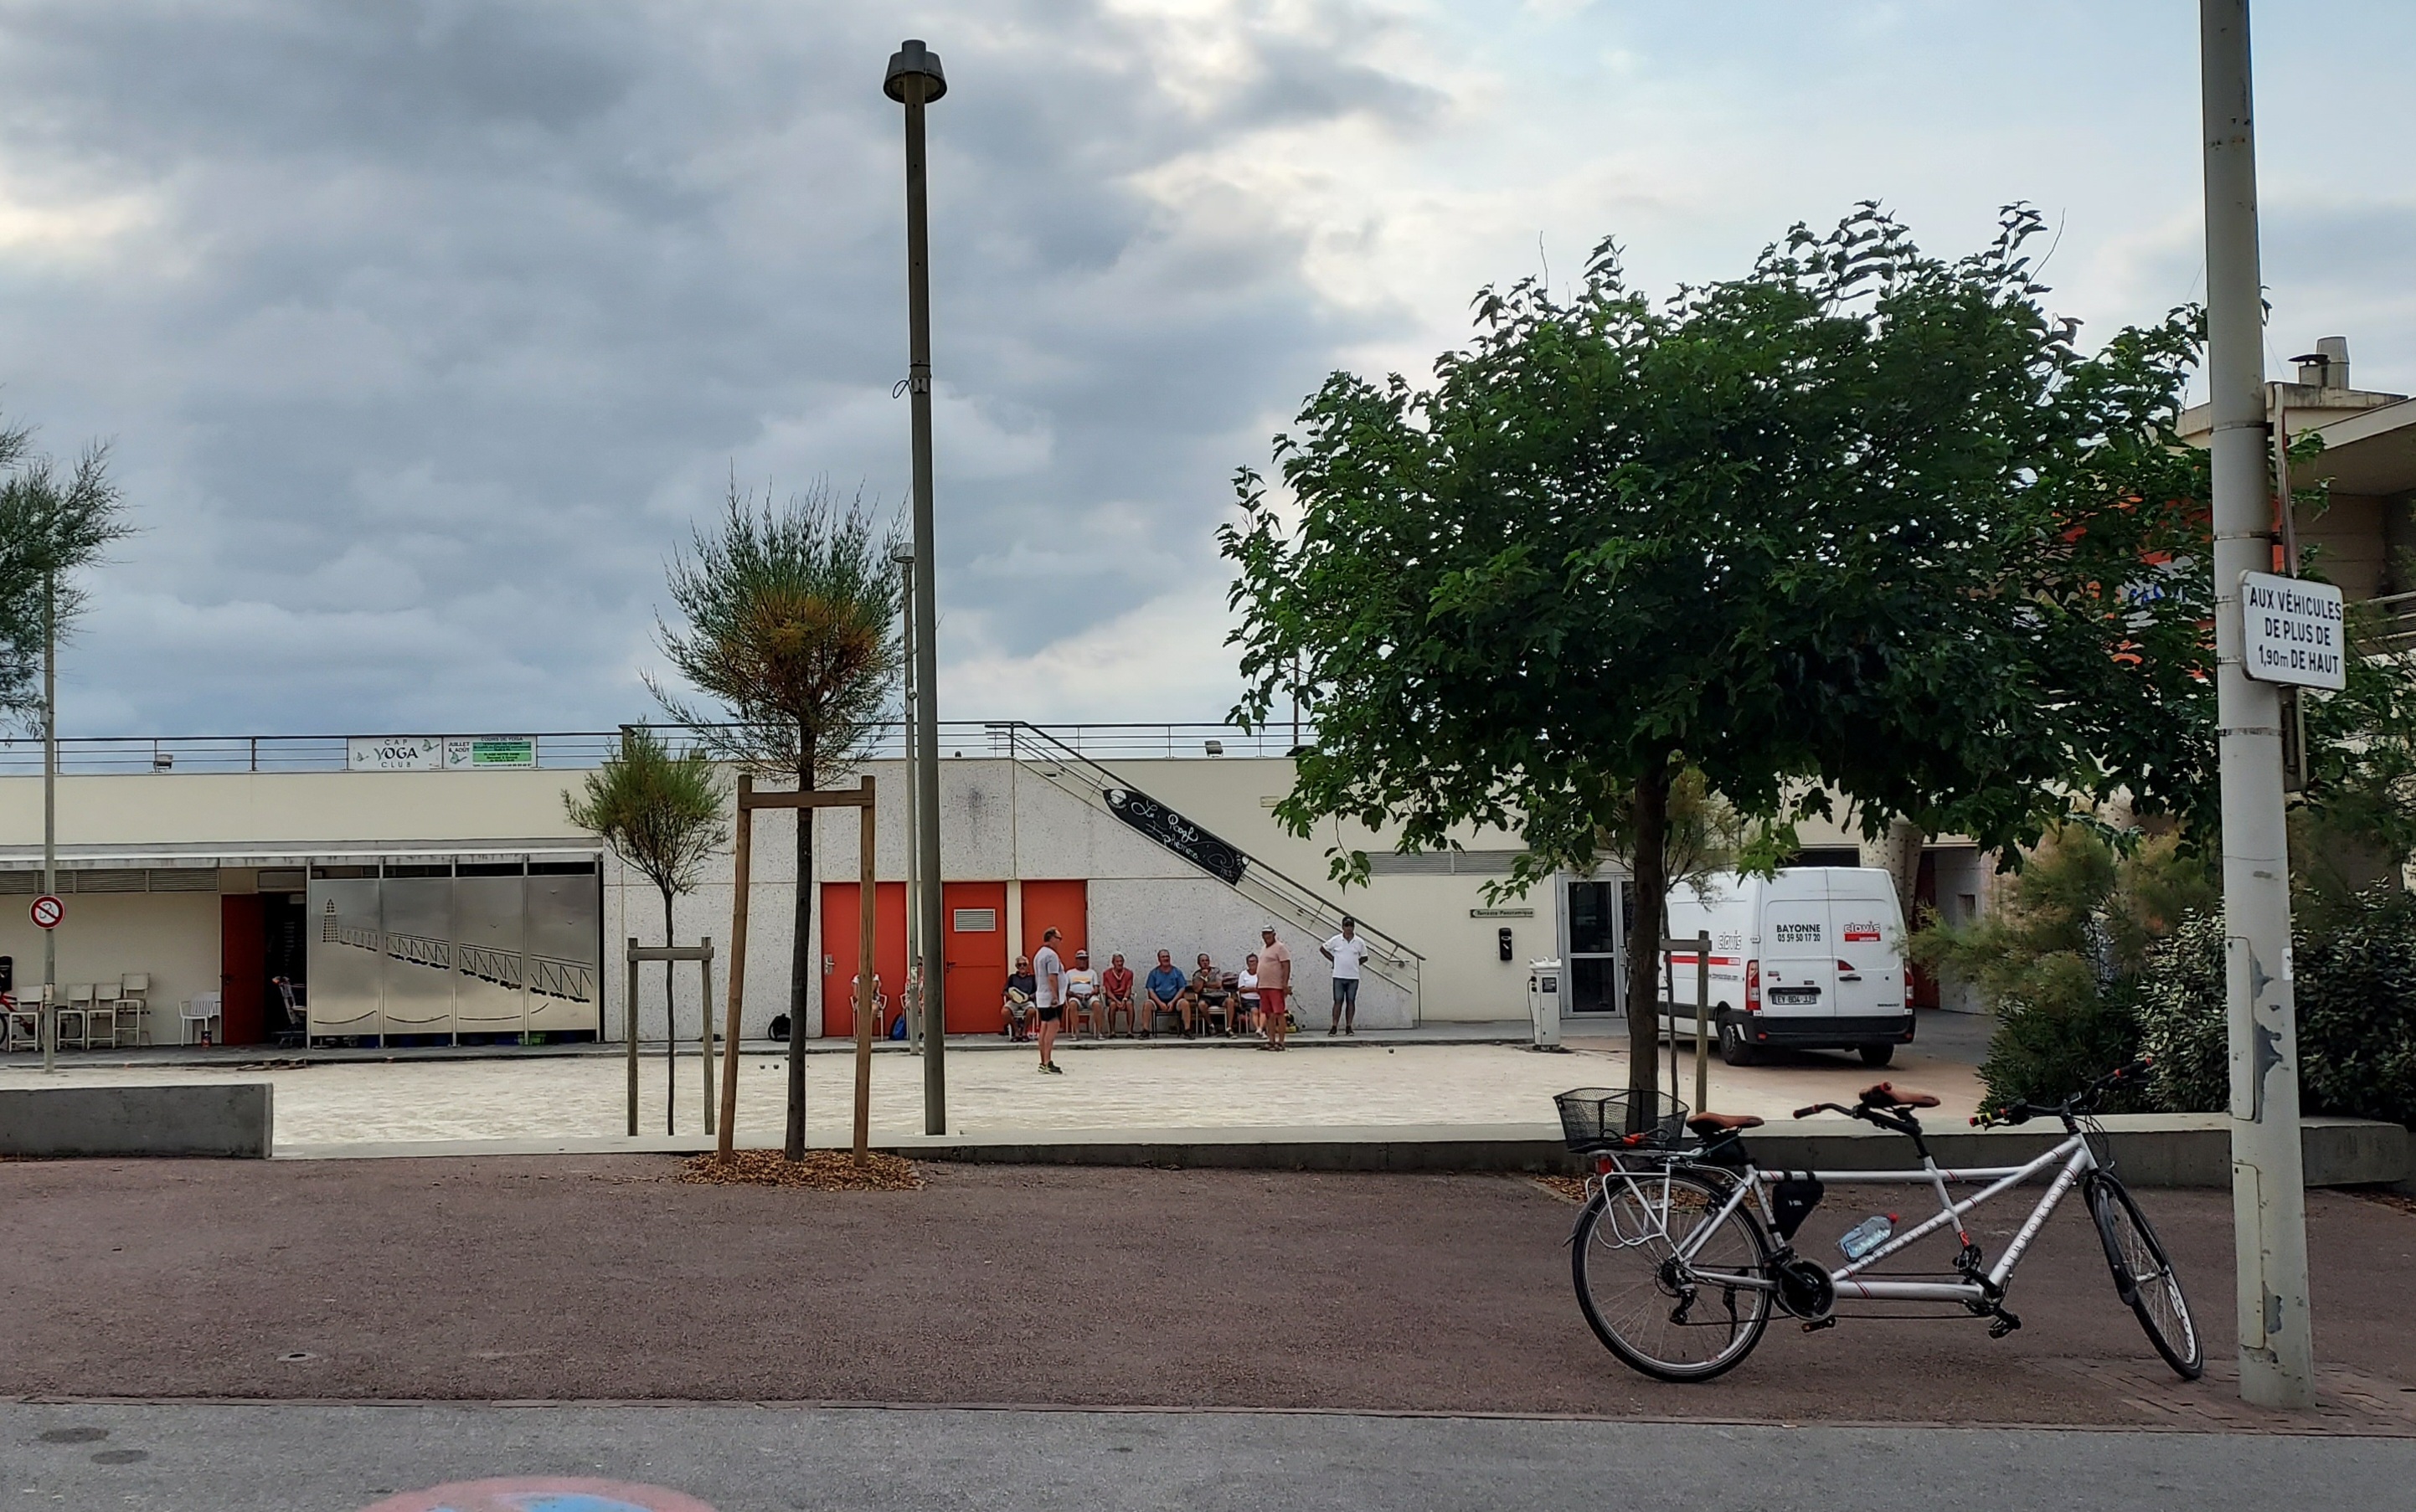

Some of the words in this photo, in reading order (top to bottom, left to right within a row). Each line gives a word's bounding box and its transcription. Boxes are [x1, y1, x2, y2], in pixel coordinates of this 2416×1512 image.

[2249, 586, 2274, 609] AUX
[2277, 589, 2341, 621] VÉHICULES
[2264, 617, 2280, 639] DE
[2283, 620, 2313, 644] PLUS
[2316, 625, 2331, 646] DE
[2259, 644, 2289, 668] 1,90m
[2290, 649, 2306, 671] DE
[2309, 651, 2339, 675] HAUT
[373, 747, 419, 761] YOGA
[1776, 924, 1821, 933] BAYONNE
[1843, 921, 1881, 933] clovis
[1778, 933, 1785, 942] 05
[1787, 933, 1794, 942] 59
[1795, 933, 1803, 942] 50
[1805, 933, 1811, 942] 17
[1813, 933, 1821, 942] 20
